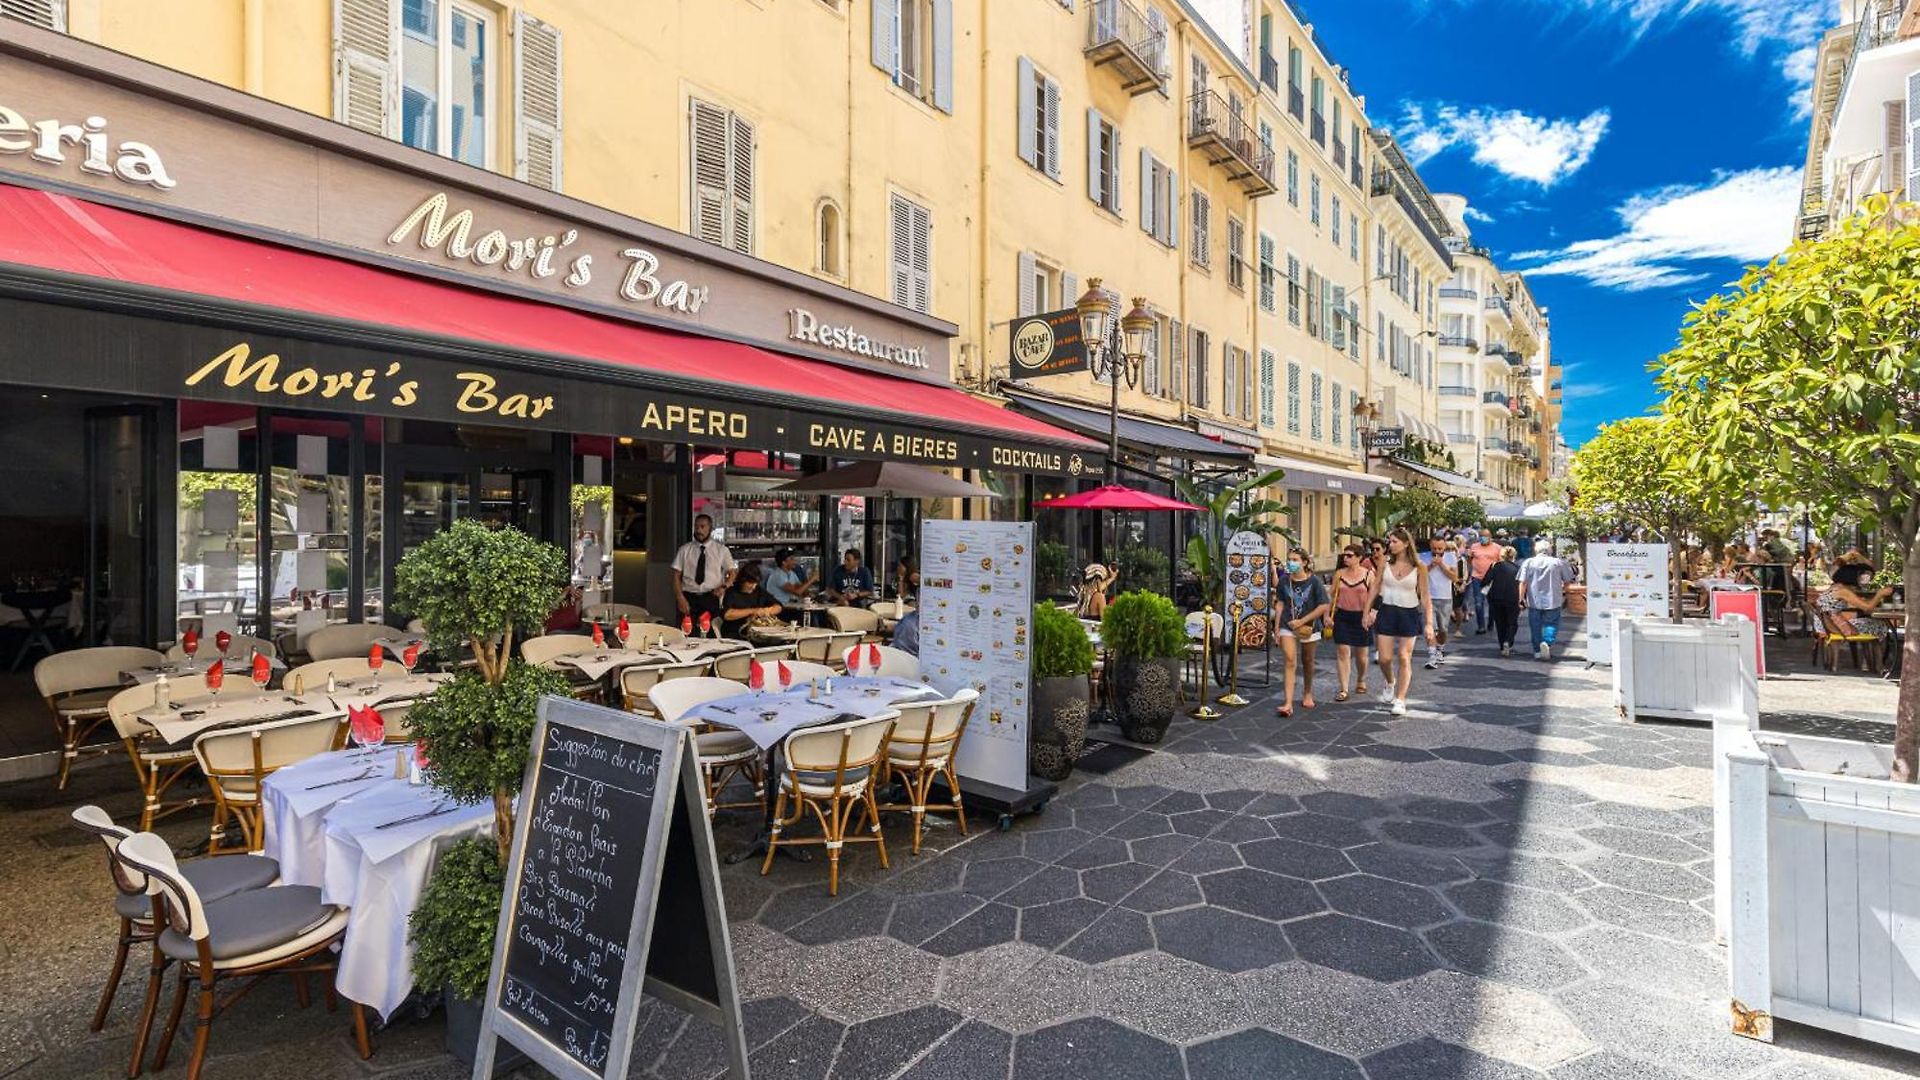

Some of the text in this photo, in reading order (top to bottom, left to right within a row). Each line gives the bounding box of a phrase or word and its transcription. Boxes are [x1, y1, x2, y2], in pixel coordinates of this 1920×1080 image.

[387, 192, 709, 314] Mori's Bar
[788, 307, 930, 370] Restaurant
[185, 342, 554, 419] Mori's Bar
[641, 402, 1061, 471] APERO CAVE A BIERES COCKTAILS
[611, 743, 627, 768] du
